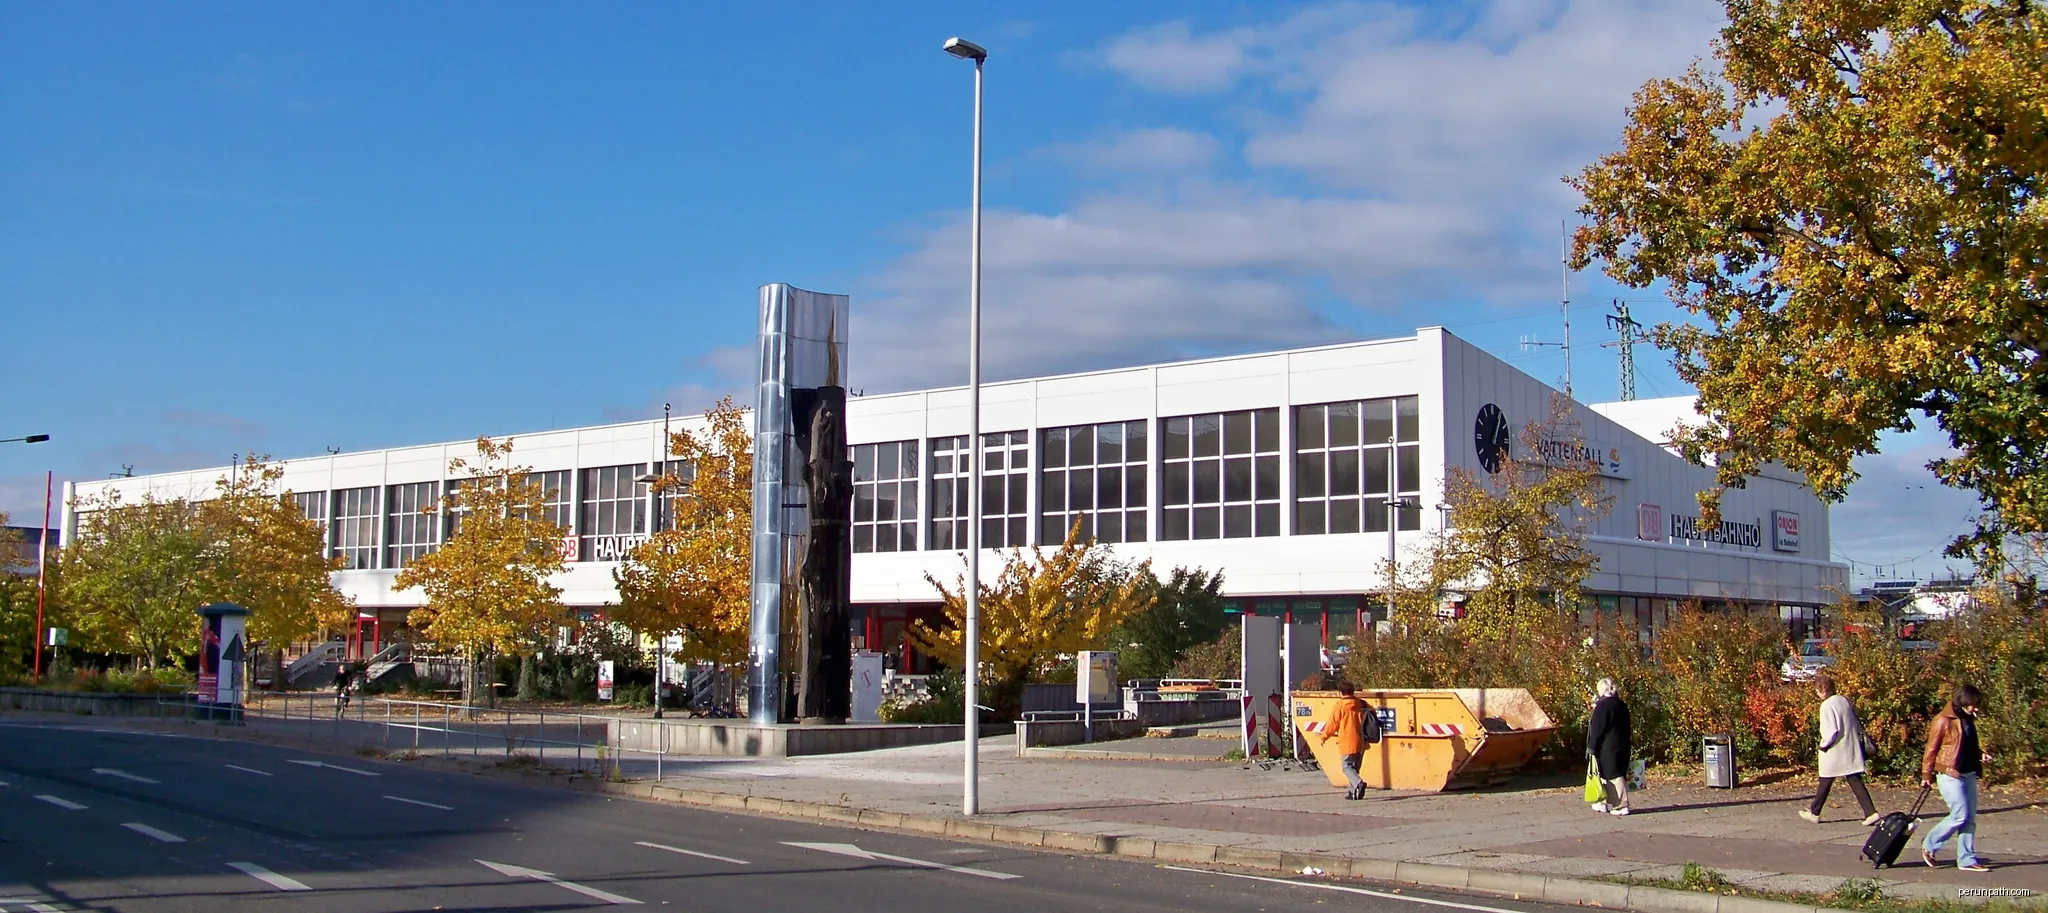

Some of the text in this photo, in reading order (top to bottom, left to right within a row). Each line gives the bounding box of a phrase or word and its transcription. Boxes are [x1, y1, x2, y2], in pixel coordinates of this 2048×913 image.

[1537, 438, 1604, 466] VATTENFALL
[1643, 508, 1659, 535] DB
[1674, 513, 1760, 547] HAUBAHNHO
[1777, 515, 1798, 531] ORION
[861, 669, 872, 687] T
